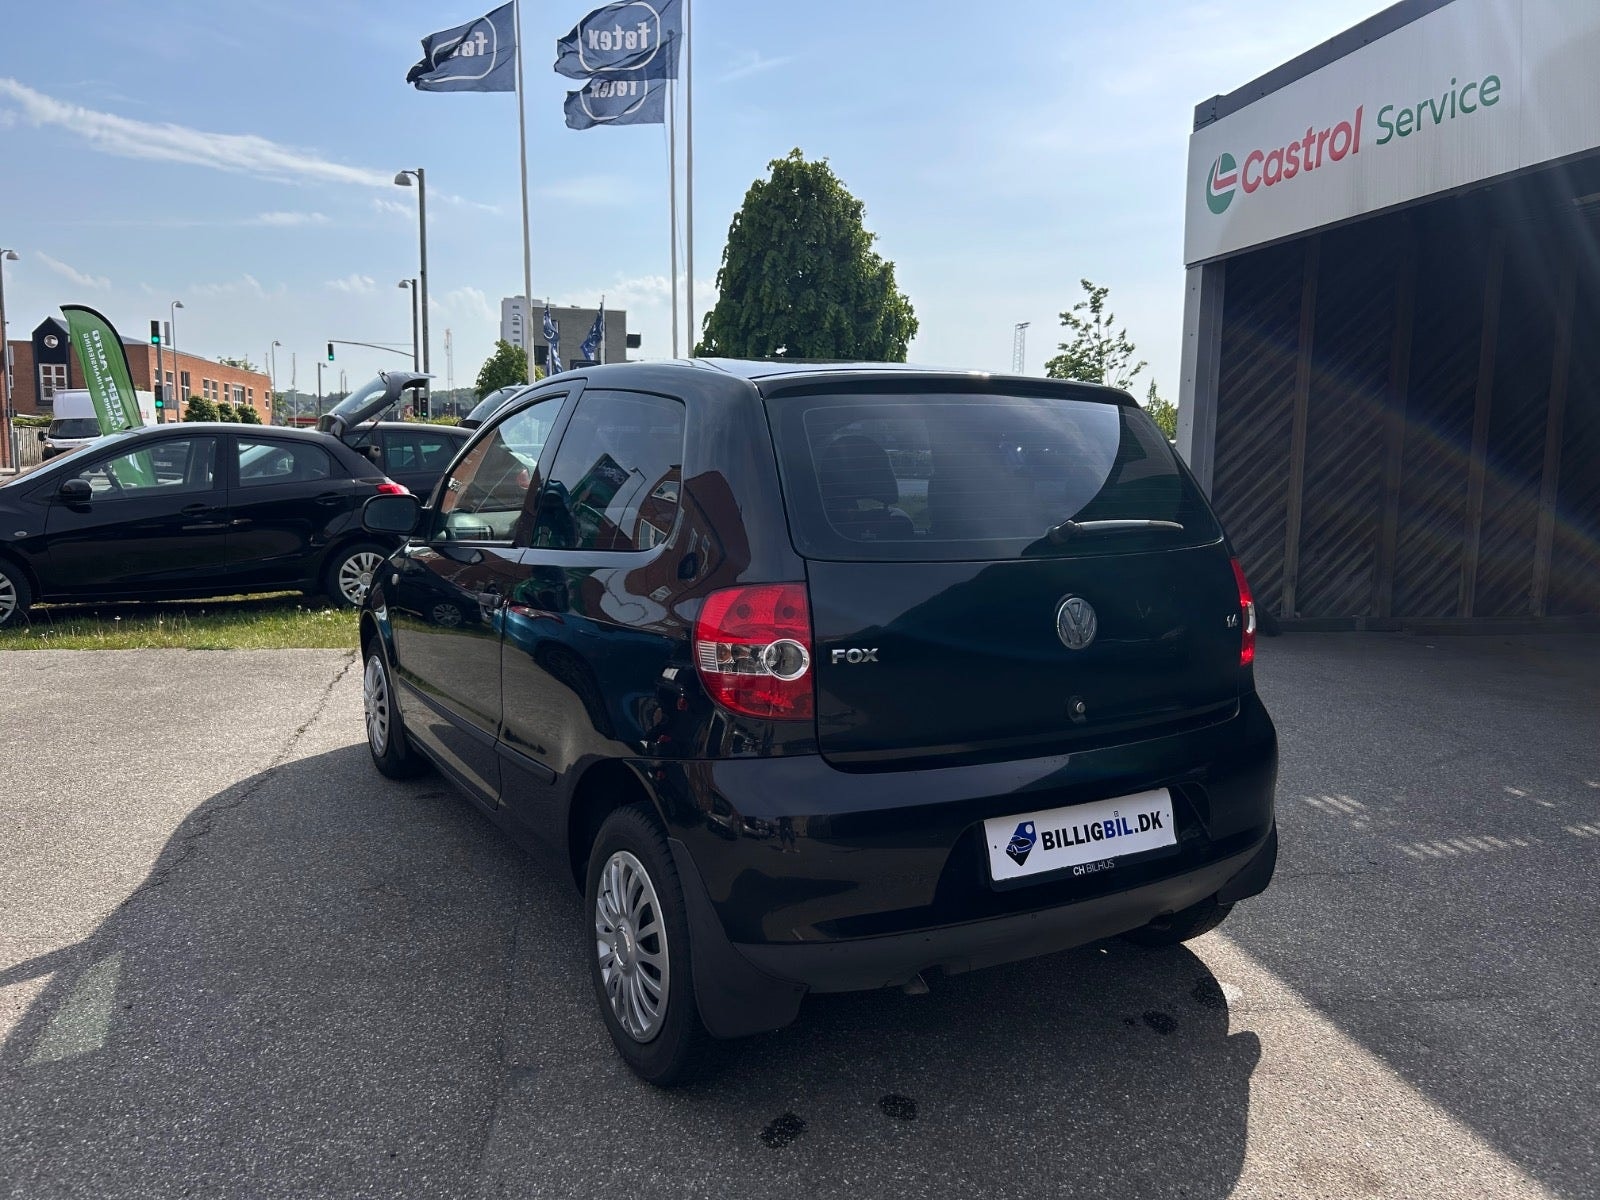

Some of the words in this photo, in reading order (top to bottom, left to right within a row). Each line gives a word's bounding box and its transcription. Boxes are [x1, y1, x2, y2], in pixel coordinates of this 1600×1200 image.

[1241, 104, 1363, 194] Castrol
[1376, 74, 1501, 146] Service
[831, 647, 879, 665] FOX
[1041, 811, 1163, 851] BILLIGBIL.DK
[1073, 865, 1086, 876] CH
[1086, 859, 1115, 873] BILHUS
